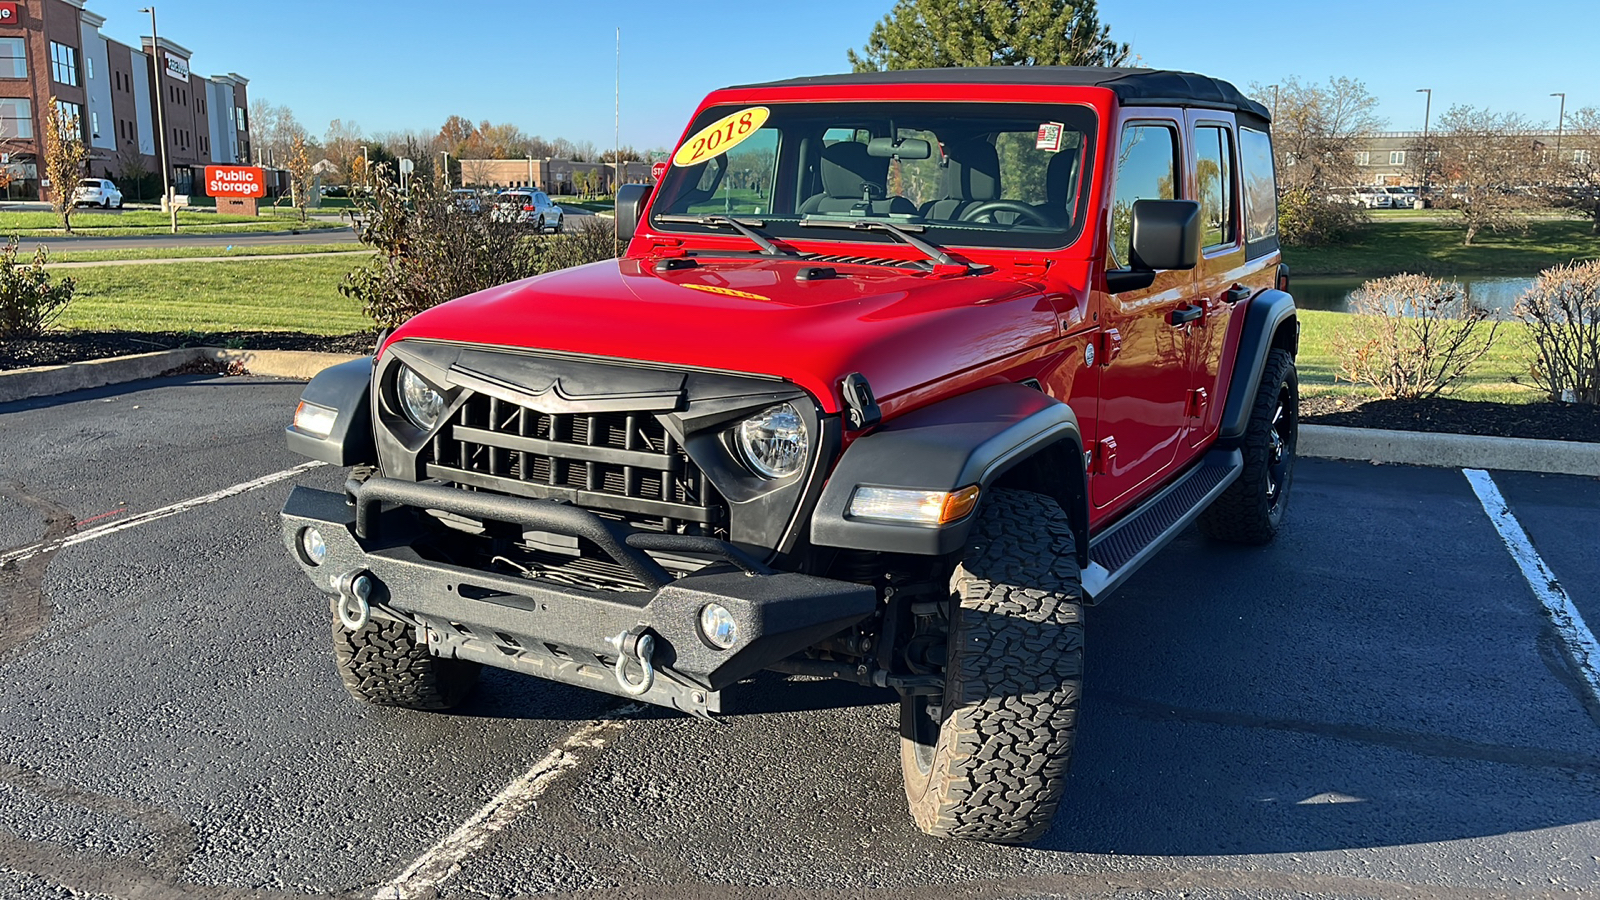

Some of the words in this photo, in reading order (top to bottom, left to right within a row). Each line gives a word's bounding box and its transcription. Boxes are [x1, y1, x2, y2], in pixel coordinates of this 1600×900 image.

[691, 112, 752, 161] 2018
[215, 170, 254, 181] Public
[653, 167, 665, 176] STO
[210, 180, 259, 195] Storage
